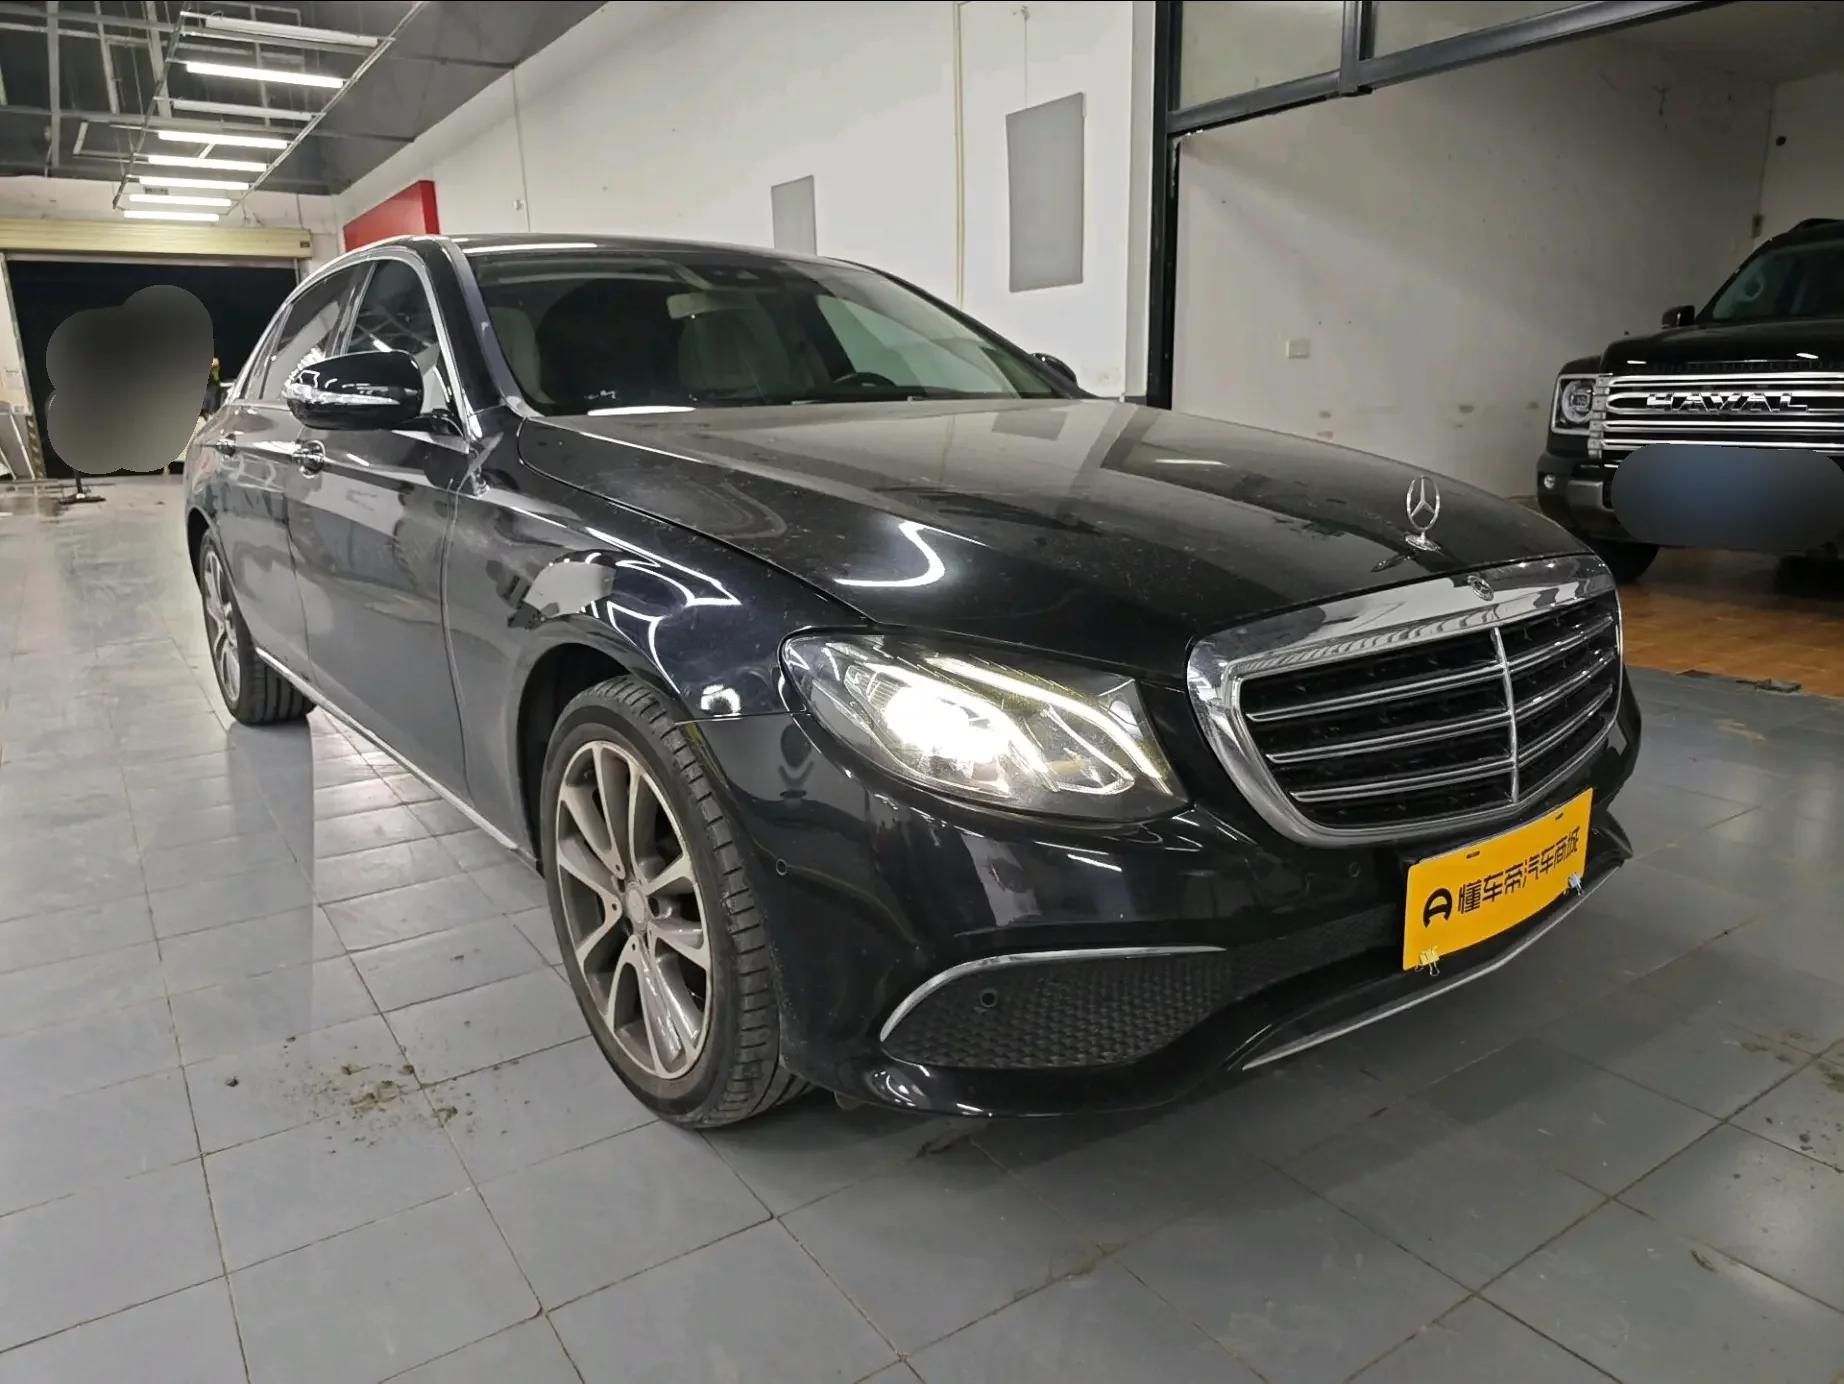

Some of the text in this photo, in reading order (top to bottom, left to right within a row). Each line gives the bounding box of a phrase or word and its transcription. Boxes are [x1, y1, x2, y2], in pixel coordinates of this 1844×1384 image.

[1646, 392, 1808, 412] HAVAL
[1457, 826, 1580, 914] 懂车帝汽车商城
